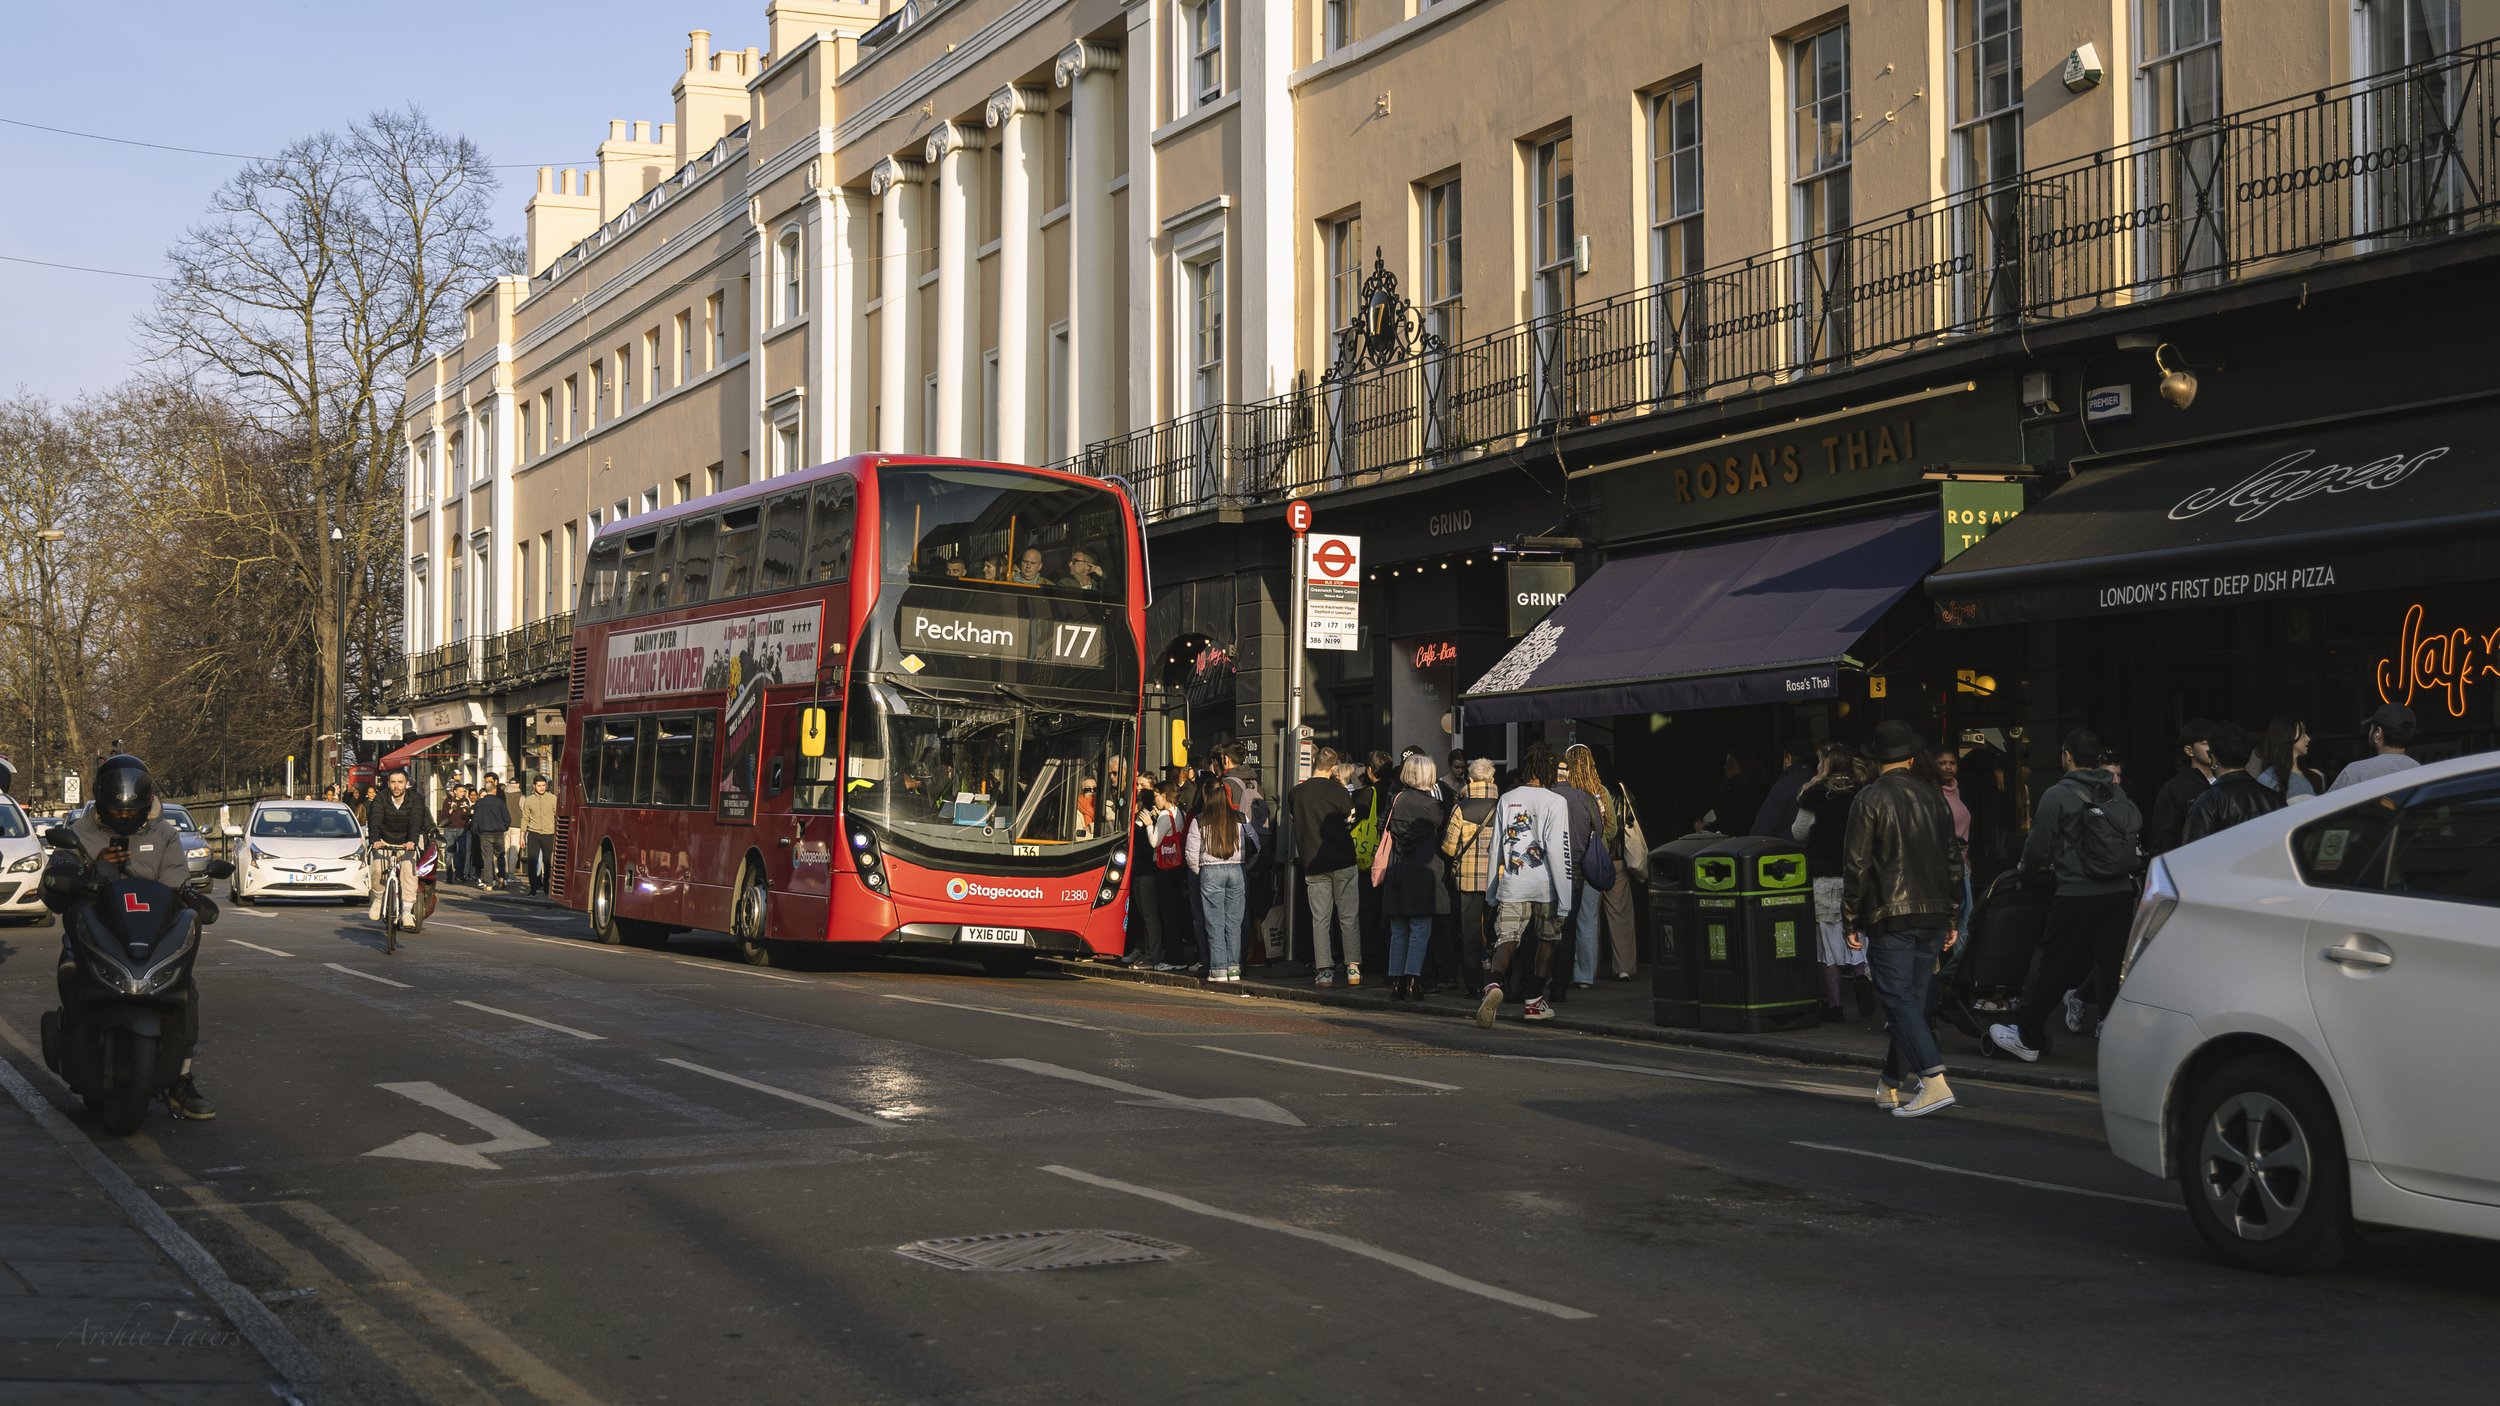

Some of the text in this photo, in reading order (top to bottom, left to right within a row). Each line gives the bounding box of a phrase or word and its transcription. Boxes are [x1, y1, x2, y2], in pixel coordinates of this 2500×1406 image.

[2089, 395, 2119, 409] PREMIER
[1674, 420, 1915, 504] ROSA'S THAI
[1294, 505, 1307, 529] E
[1429, 510, 1472, 537] GRIND
[2099, 565, 2335, 609] LONDON'S FIRST DEEP DISH PIZZA
[1516, 592, 1567, 607] GRIND
[634, 630, 678, 653] DANNY DYER
[915, 616, 1098, 659] Peckham 177
[606, 647, 705, 695] MARCHING POWDER
[1785, 676, 1831, 693] Rosa's Thai
[1875, 682, 1882, 692] S
[800, 848, 831, 867] Stagecoach
[1018, 847, 1037, 857] 136
[968, 882, 1044, 900] Stagecoach
[1061, 890, 1088, 902] 12380
[124, 893, 151, 913] L
[969, 928, 1018, 942] YX16 OGU
